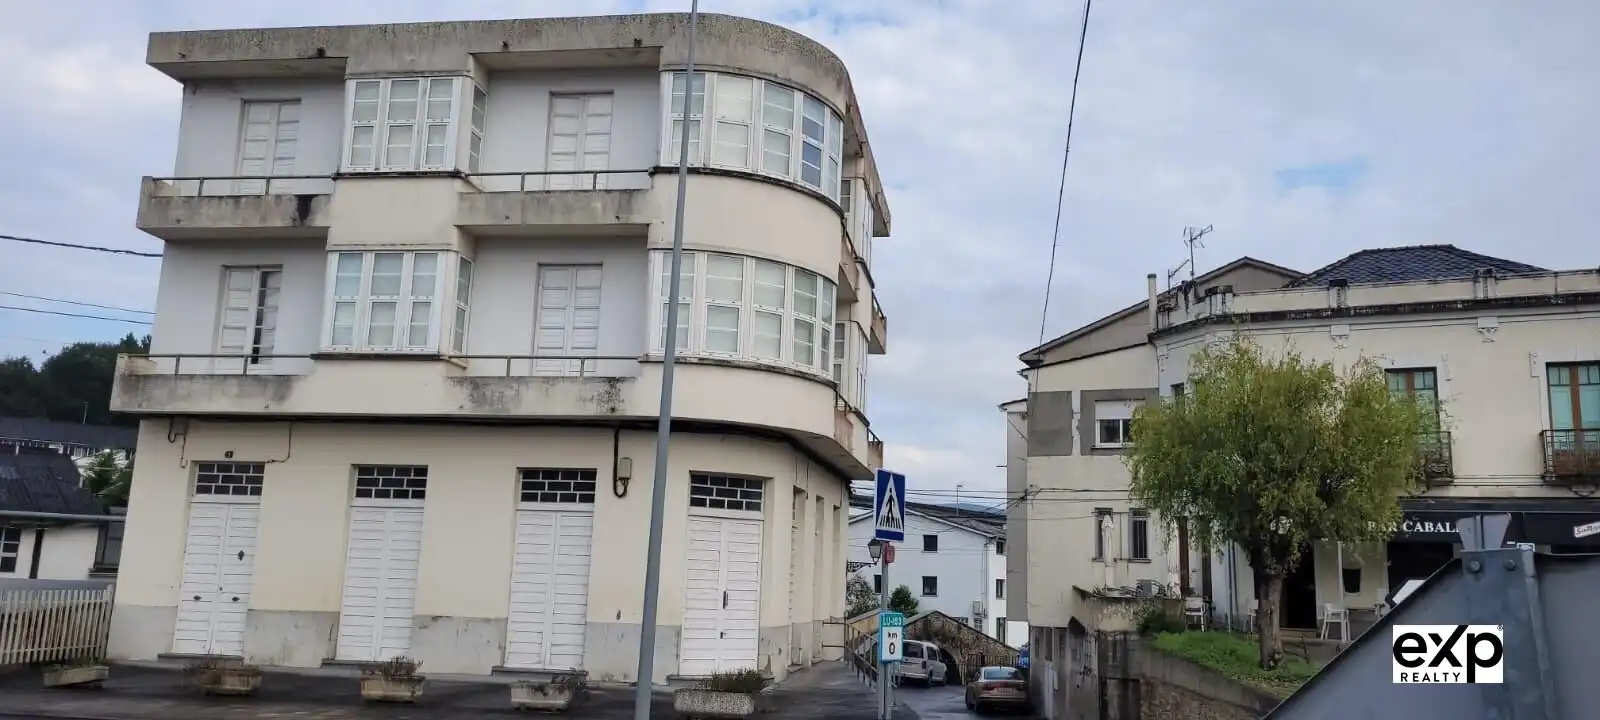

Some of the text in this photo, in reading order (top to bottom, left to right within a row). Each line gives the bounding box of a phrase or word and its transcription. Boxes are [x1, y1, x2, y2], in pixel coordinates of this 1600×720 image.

[1402, 520, 1460, 533] CABAL
[887, 631, 898, 639] km
[888, 642, 896, 655] 0
